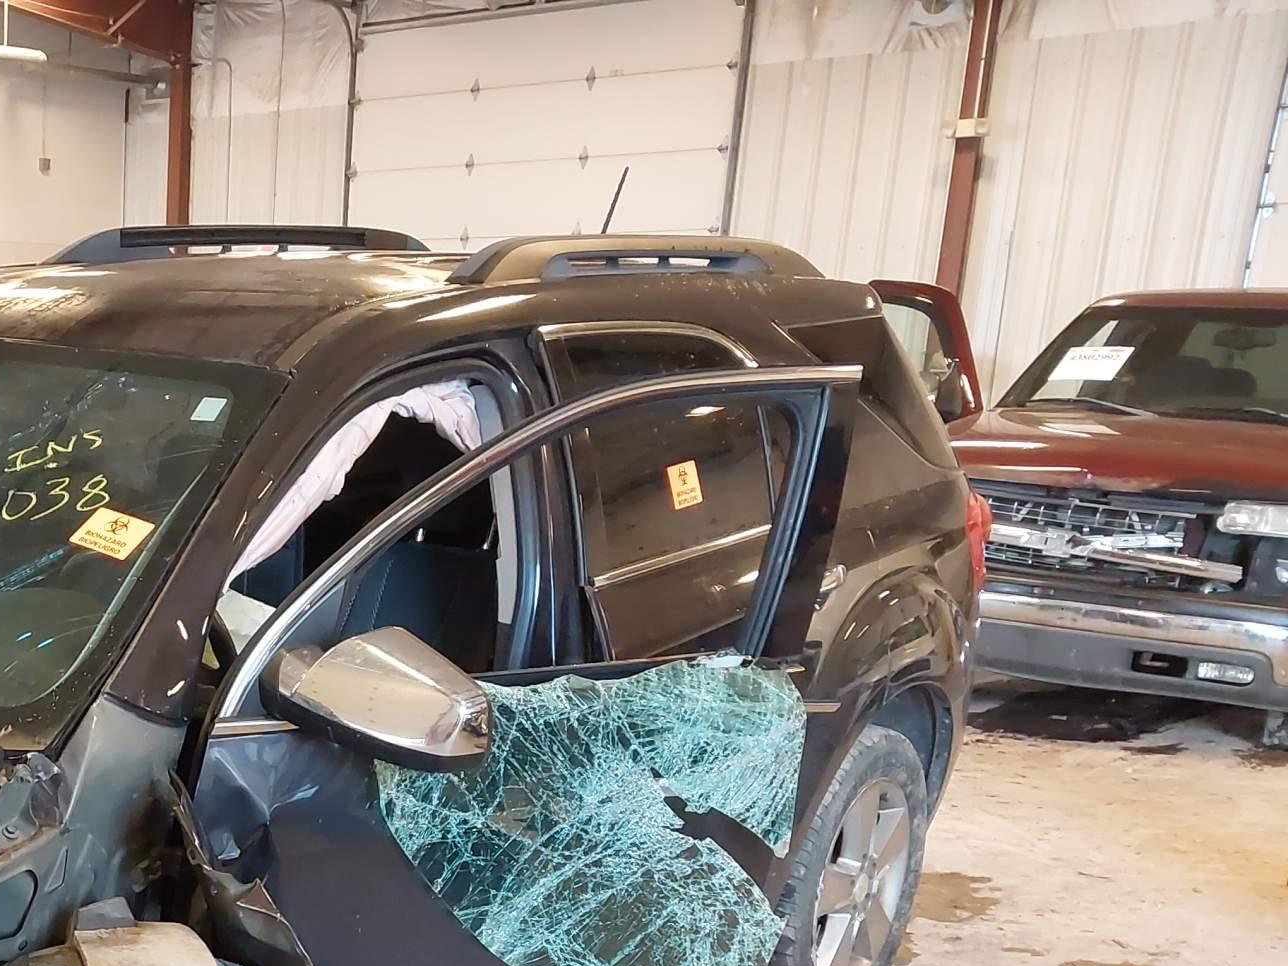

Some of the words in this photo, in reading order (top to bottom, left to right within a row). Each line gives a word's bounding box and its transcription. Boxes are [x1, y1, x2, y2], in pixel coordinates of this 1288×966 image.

[4, 429, 103, 472] INS
[78, 537, 121, 555] BIOPELIGRO
[85, 530, 127, 548] BIOHAZARD
